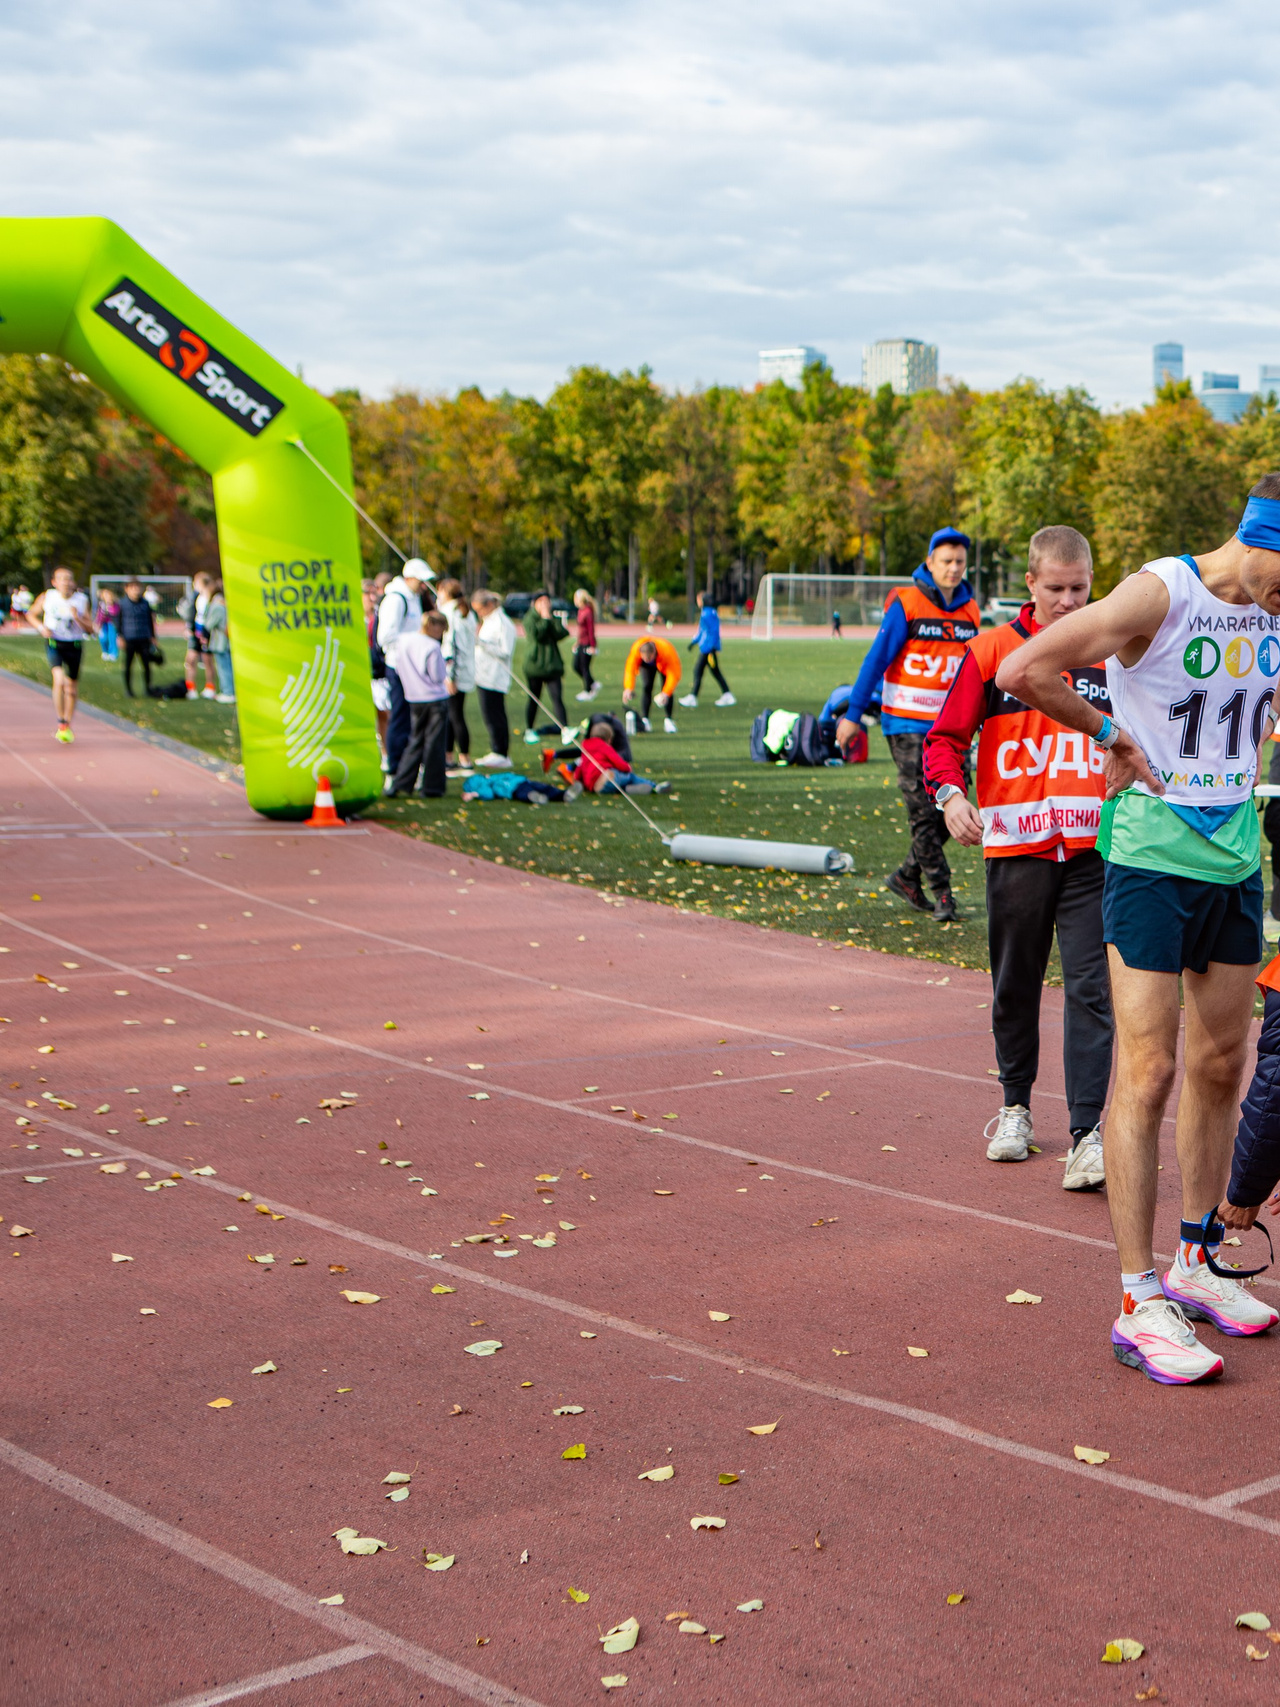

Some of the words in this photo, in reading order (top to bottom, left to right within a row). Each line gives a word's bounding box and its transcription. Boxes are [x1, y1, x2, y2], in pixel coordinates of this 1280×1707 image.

[104, 290, 170, 347] Arta
[195, 360, 272, 428] Sport
[260, 560, 333, 583] СПОРТ
[262, 583, 350, 607] НОРМА
[266, 607, 353, 632] ЖИЗНИ
[918, 624, 942, 636] Arta
[954, 625, 975, 638] Sport
[1188, 616, 1280, 632] VMARAFONE
[903, 652, 963, 683] СУД
[1076, 679, 1110, 700] Spo
[997, 732, 1107, 780] СУДЬ
